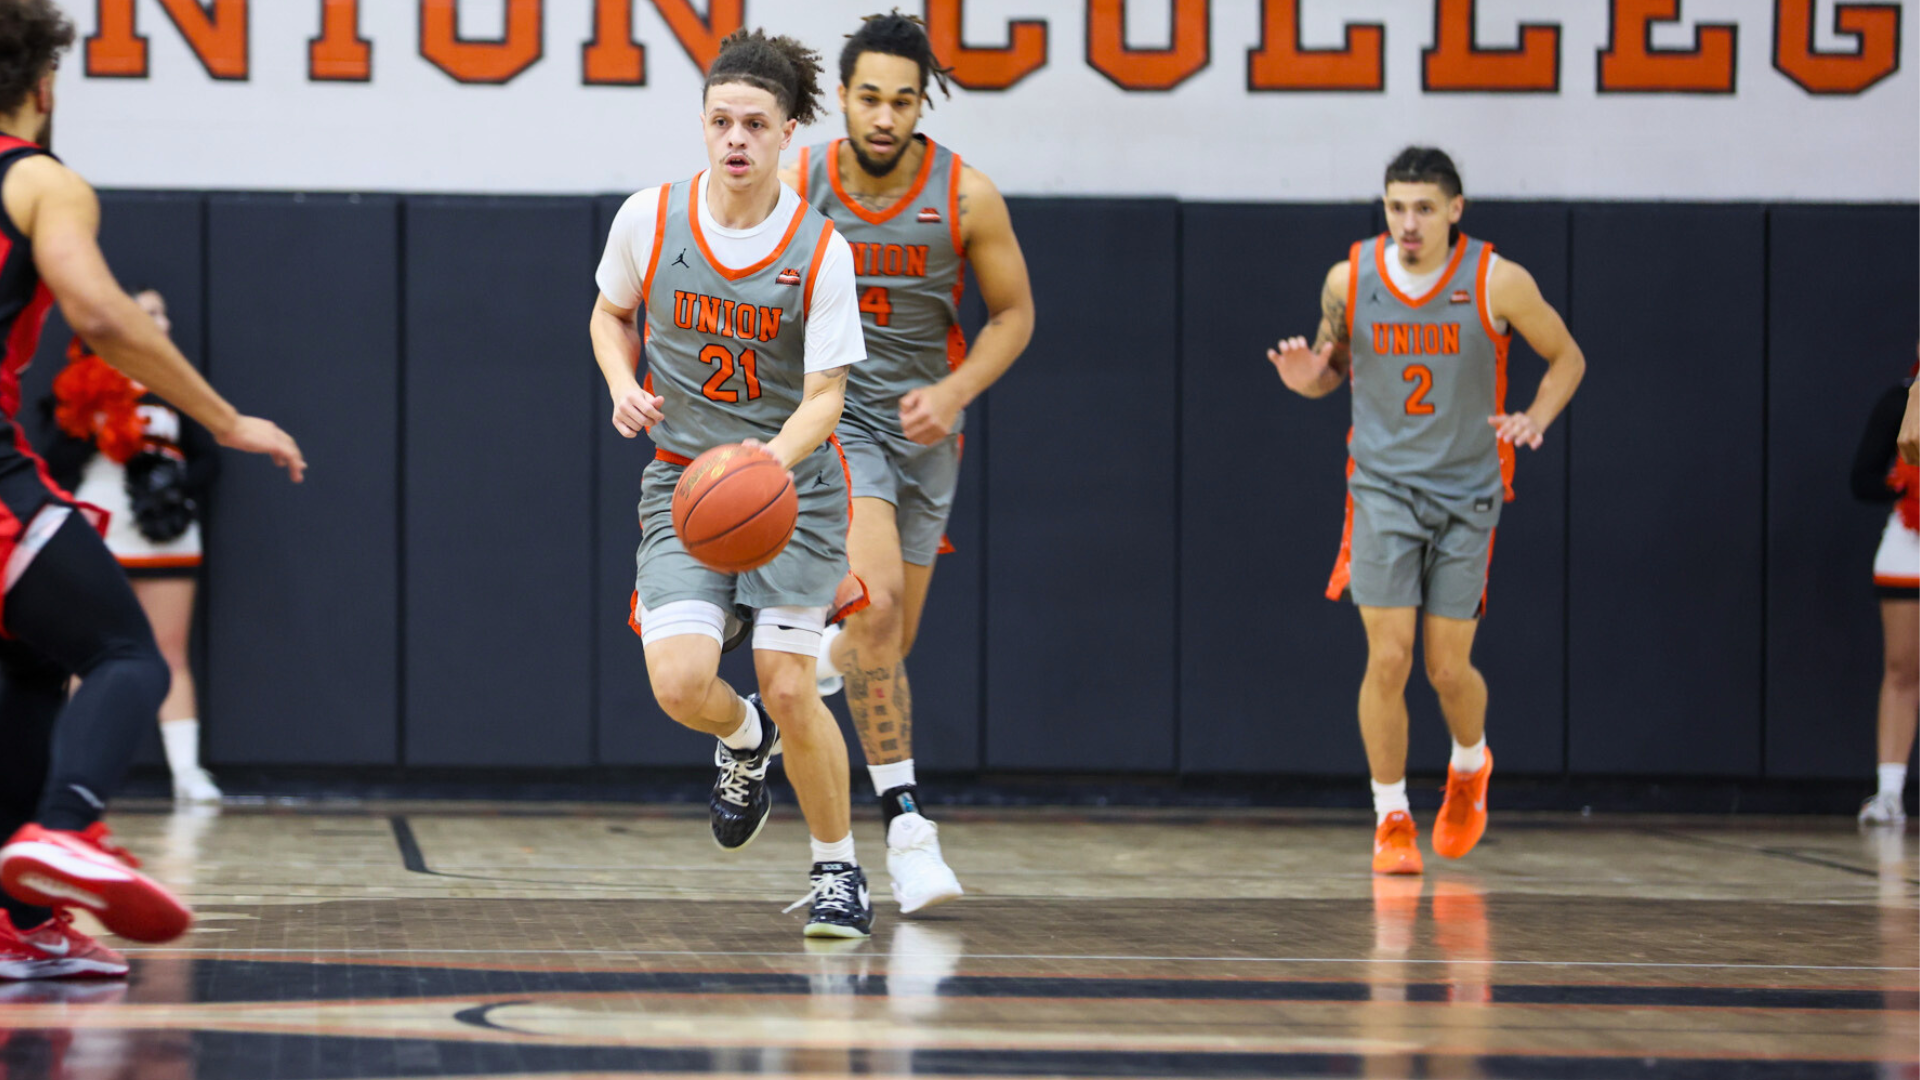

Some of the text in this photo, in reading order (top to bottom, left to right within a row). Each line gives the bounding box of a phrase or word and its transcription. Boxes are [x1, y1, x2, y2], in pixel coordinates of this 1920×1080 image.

[83, 0, 746, 86] NION
[848, 241, 930, 277] NION
[674, 290, 783, 342] UNION
[859, 286, 893, 327] 4
[1372, 321, 1461, 356] UNION
[699, 342, 763, 404] 21
[1402, 363, 1436, 416] 2
